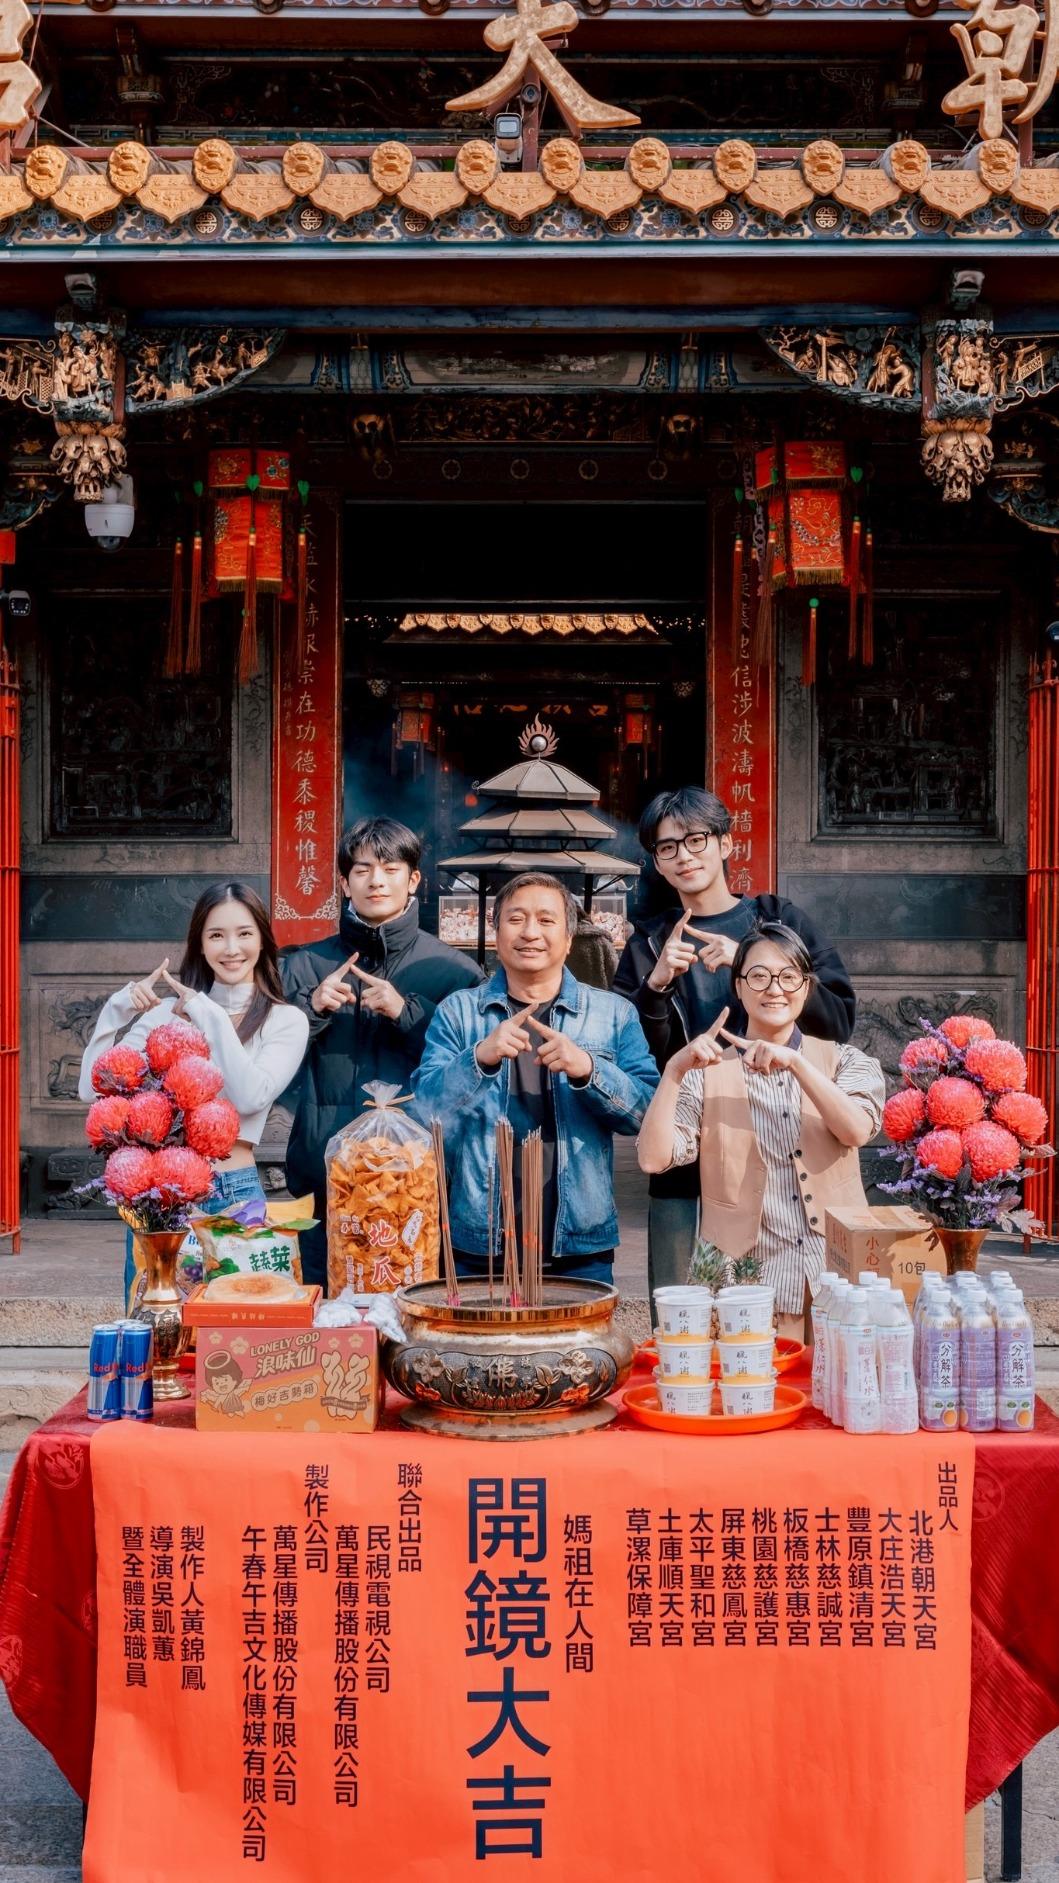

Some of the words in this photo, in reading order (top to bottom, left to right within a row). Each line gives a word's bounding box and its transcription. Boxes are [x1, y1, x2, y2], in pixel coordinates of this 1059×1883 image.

[249, 1245, 291, 1272] 蔬菜
[368, 1218, 401, 1285] 地瓜
[865, 1235, 880, 1272] 小心
[898, 1261, 926, 1276] 10包
[93, 1362, 111, 1372] Red
[126, 1362, 144, 1372] Red
[250, 1337, 293, 1358] LONELY
[295, 1331, 320, 1347] GOD
[255, 1346, 317, 1379] 浪味仙
[940, 1344, 951, 1388] 分解茶
[1010, 1344, 1025, 1388] 分解茶
[304, 1464, 329, 1573] 製作公司
[398, 1463, 423, 1572] 聯合出品
[938, 1461, 959, 1531] 出品人
[122, 1526, 147, 1688] 暨全體演職員
[180, 1525, 206, 1690] 製作人黃錦鳳
[365, 1525, 391, 1693] 民視電視公司
[563, 1514, 594, 1673] 媽祖在人間
[626, 1507, 653, 1647] 草漯保障宮
[658, 1507, 684, 1647] 土庫順天宮
[689, 1507, 716, 1647] 太平聖和宮
[721, 1508, 748, 1647] 屏東慈鳳宮
[751, 1507, 779, 1647] 桃園慈護宮
[783, 1507, 811, 1647] 板橋慈惠宮
[847, 1506, 874, 1647] 豐原鎮清宮
[878, 1507, 906, 1648] 大庄浩天宮
[909, 1510, 937, 1650] 北港朝天宮
[241, 1525, 267, 1862] 午春午吉文化傳媒有限公司
[272, 1525, 298, 1806] 萬星傳播股份有限公司
[334, 1525, 359, 1808] 萬星傳播股份有限公司
[464, 1477, 552, 1861] 開鏡大吉
